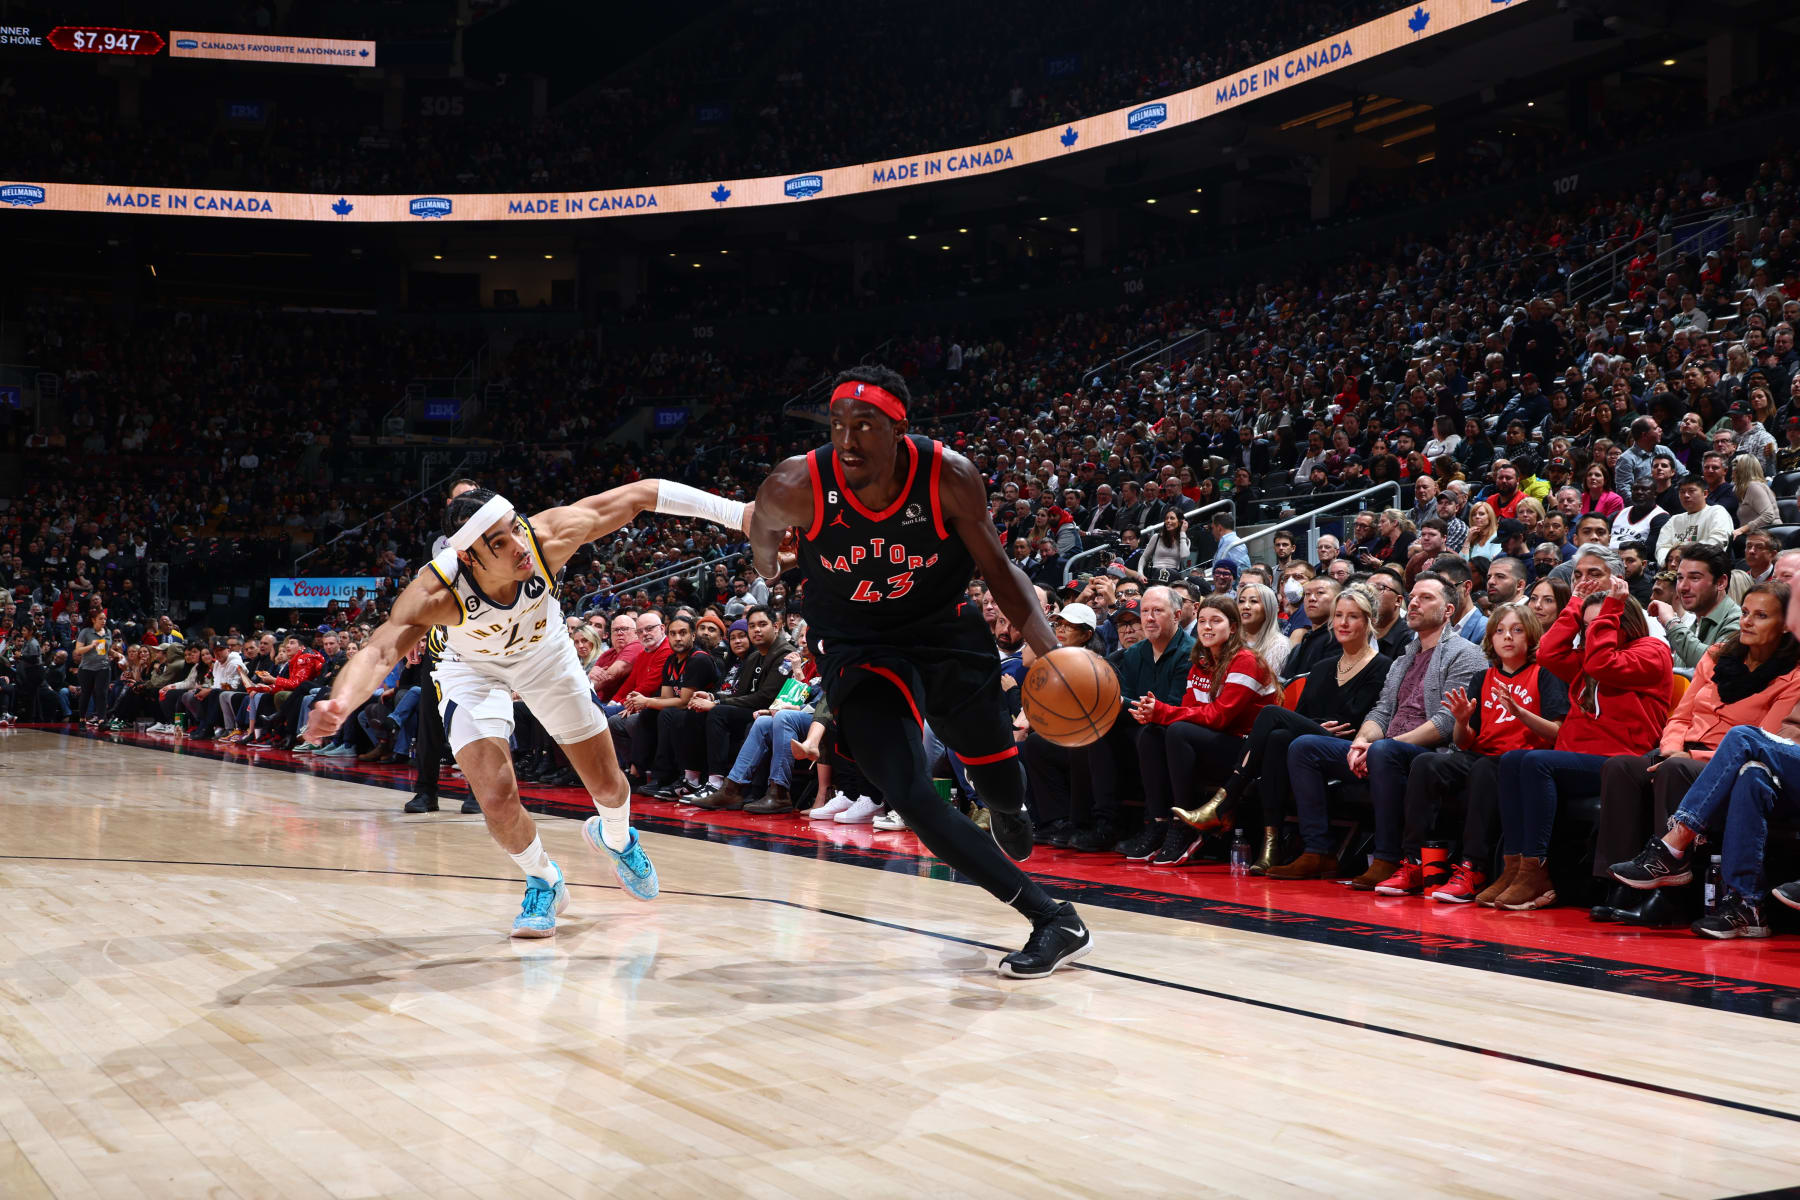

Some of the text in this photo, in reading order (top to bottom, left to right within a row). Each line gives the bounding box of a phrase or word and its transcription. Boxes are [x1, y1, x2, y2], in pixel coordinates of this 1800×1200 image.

[9, 36, 42, 46] HOME
[73, 30, 140, 52] $7,947
[201, 41, 246, 51] CANADA'S
[247, 44, 295, 54] FAVOURITE
[297, 47, 356, 57] MAYONNAISE
[1215, 40, 1353, 105] MADE IN CANADA
[420, 95, 465, 116] 305
[1130, 105, 1165, 123] HELLMANN'S
[872, 147, 1014, 184] MADE IN CANADA
[786, 177, 821, 191] HELLMANN'S
[1553, 174, 1578, 195] 107
[1, 188, 43, 199] HELLMANN'S
[106, 193, 273, 212] MADE IN CANADA
[412, 200, 451, 211] HELLMANN'S
[508, 194, 658, 214] MADE IN CANADA
[1122, 277, 1144, 295] 106
[692, 326, 714, 338] 105
[428, 403, 455, 416] IBM
[658, 412, 685, 425] IBM
[828, 490, 838, 504] 6
[901, 516, 928, 527] Sun Life
[820, 537, 939, 573] RAPTORS
[294, 580, 367, 598] Coors LIGH
[850, 571, 914, 603] 43
[467, 597, 478, 610] 6
[1484, 683, 1533, 709] RATORS
